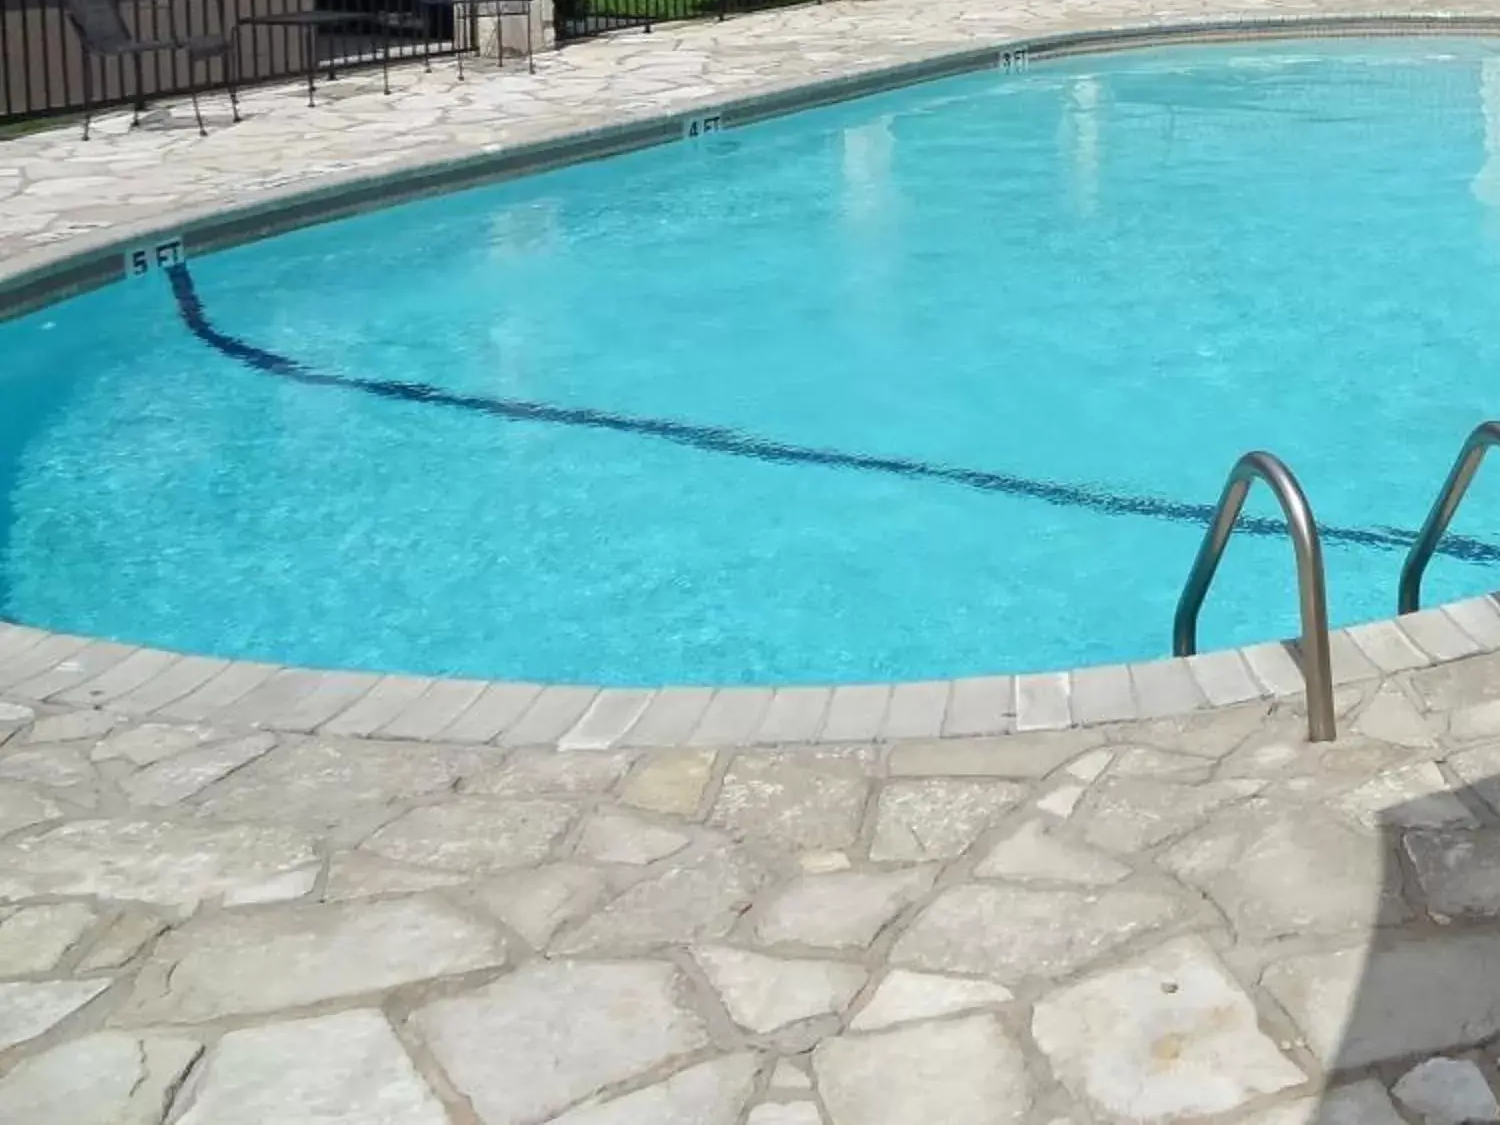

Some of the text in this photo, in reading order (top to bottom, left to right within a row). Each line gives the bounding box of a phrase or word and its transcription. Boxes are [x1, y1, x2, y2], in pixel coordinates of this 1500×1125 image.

[703, 116, 721, 133] FT
[132, 240, 181, 276] 5 FT
